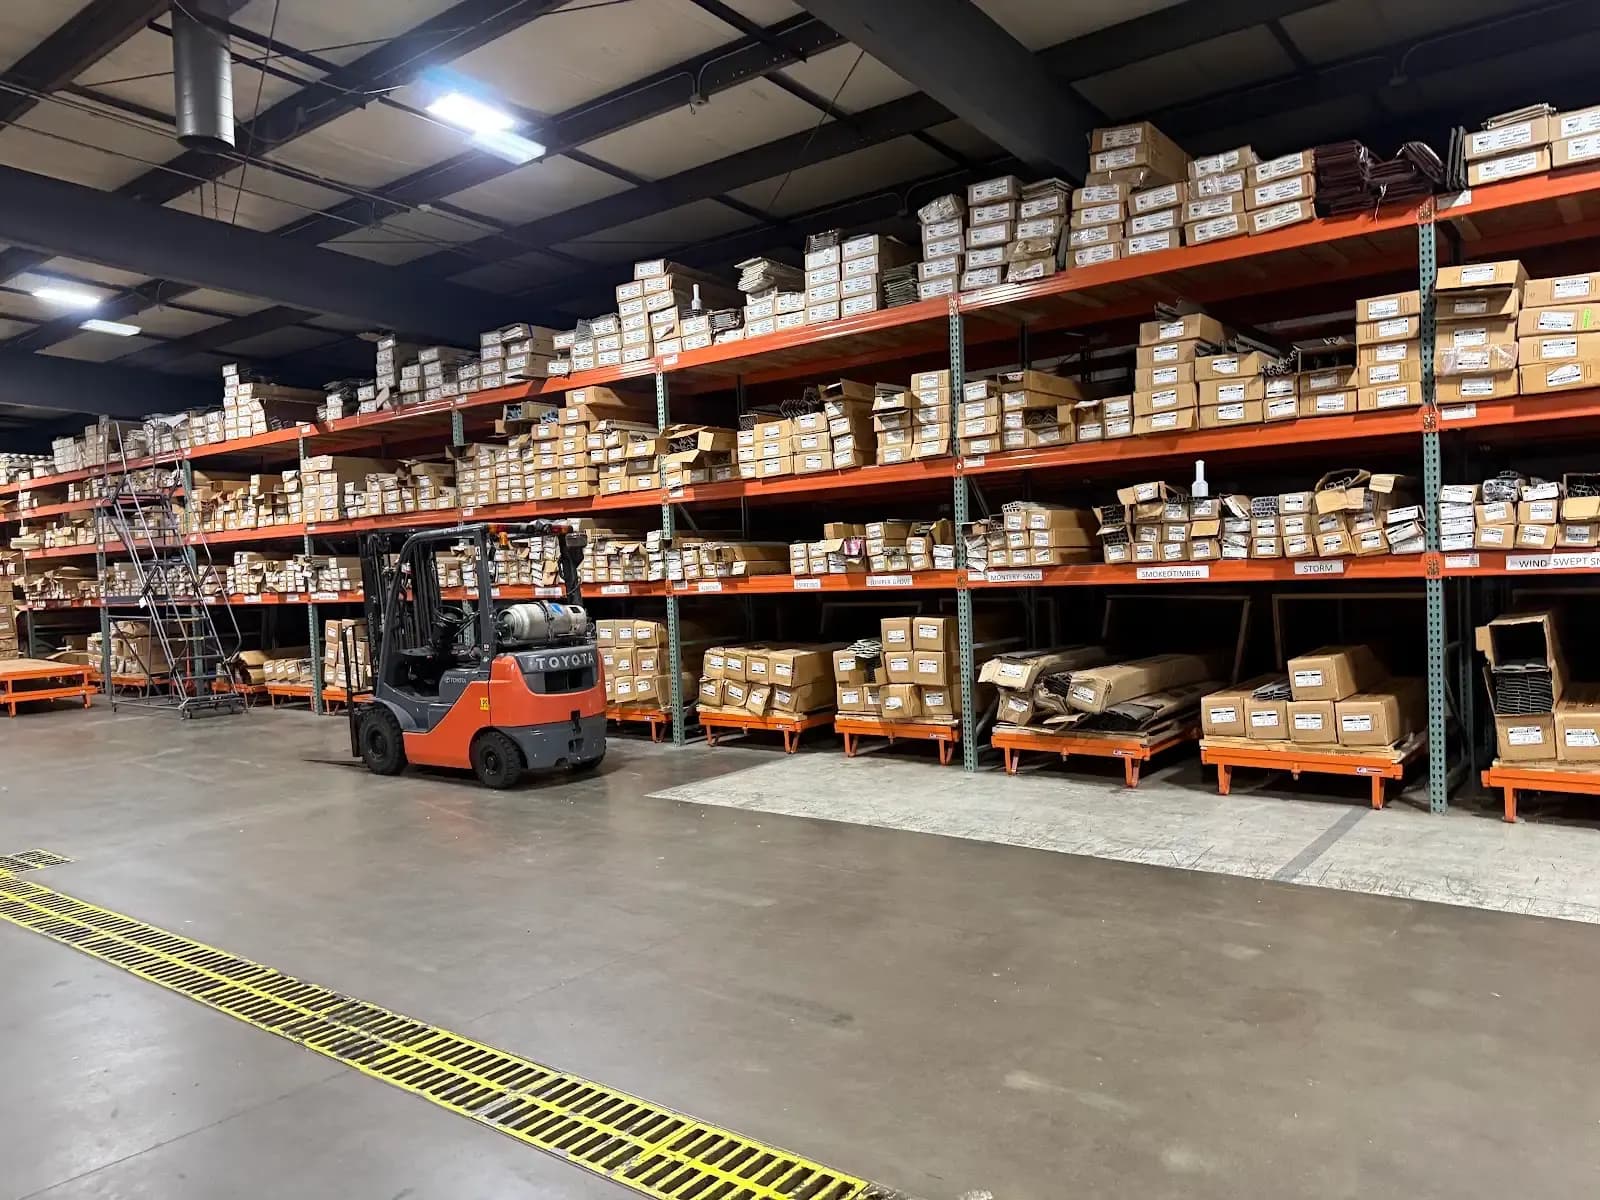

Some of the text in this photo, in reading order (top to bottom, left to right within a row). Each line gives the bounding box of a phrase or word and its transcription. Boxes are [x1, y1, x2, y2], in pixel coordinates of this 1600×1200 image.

[1553, 557, 1589, 566] SWEPT
[1303, 564, 1333, 573] STORM
[535, 652, 595, 670] TOYOTA
